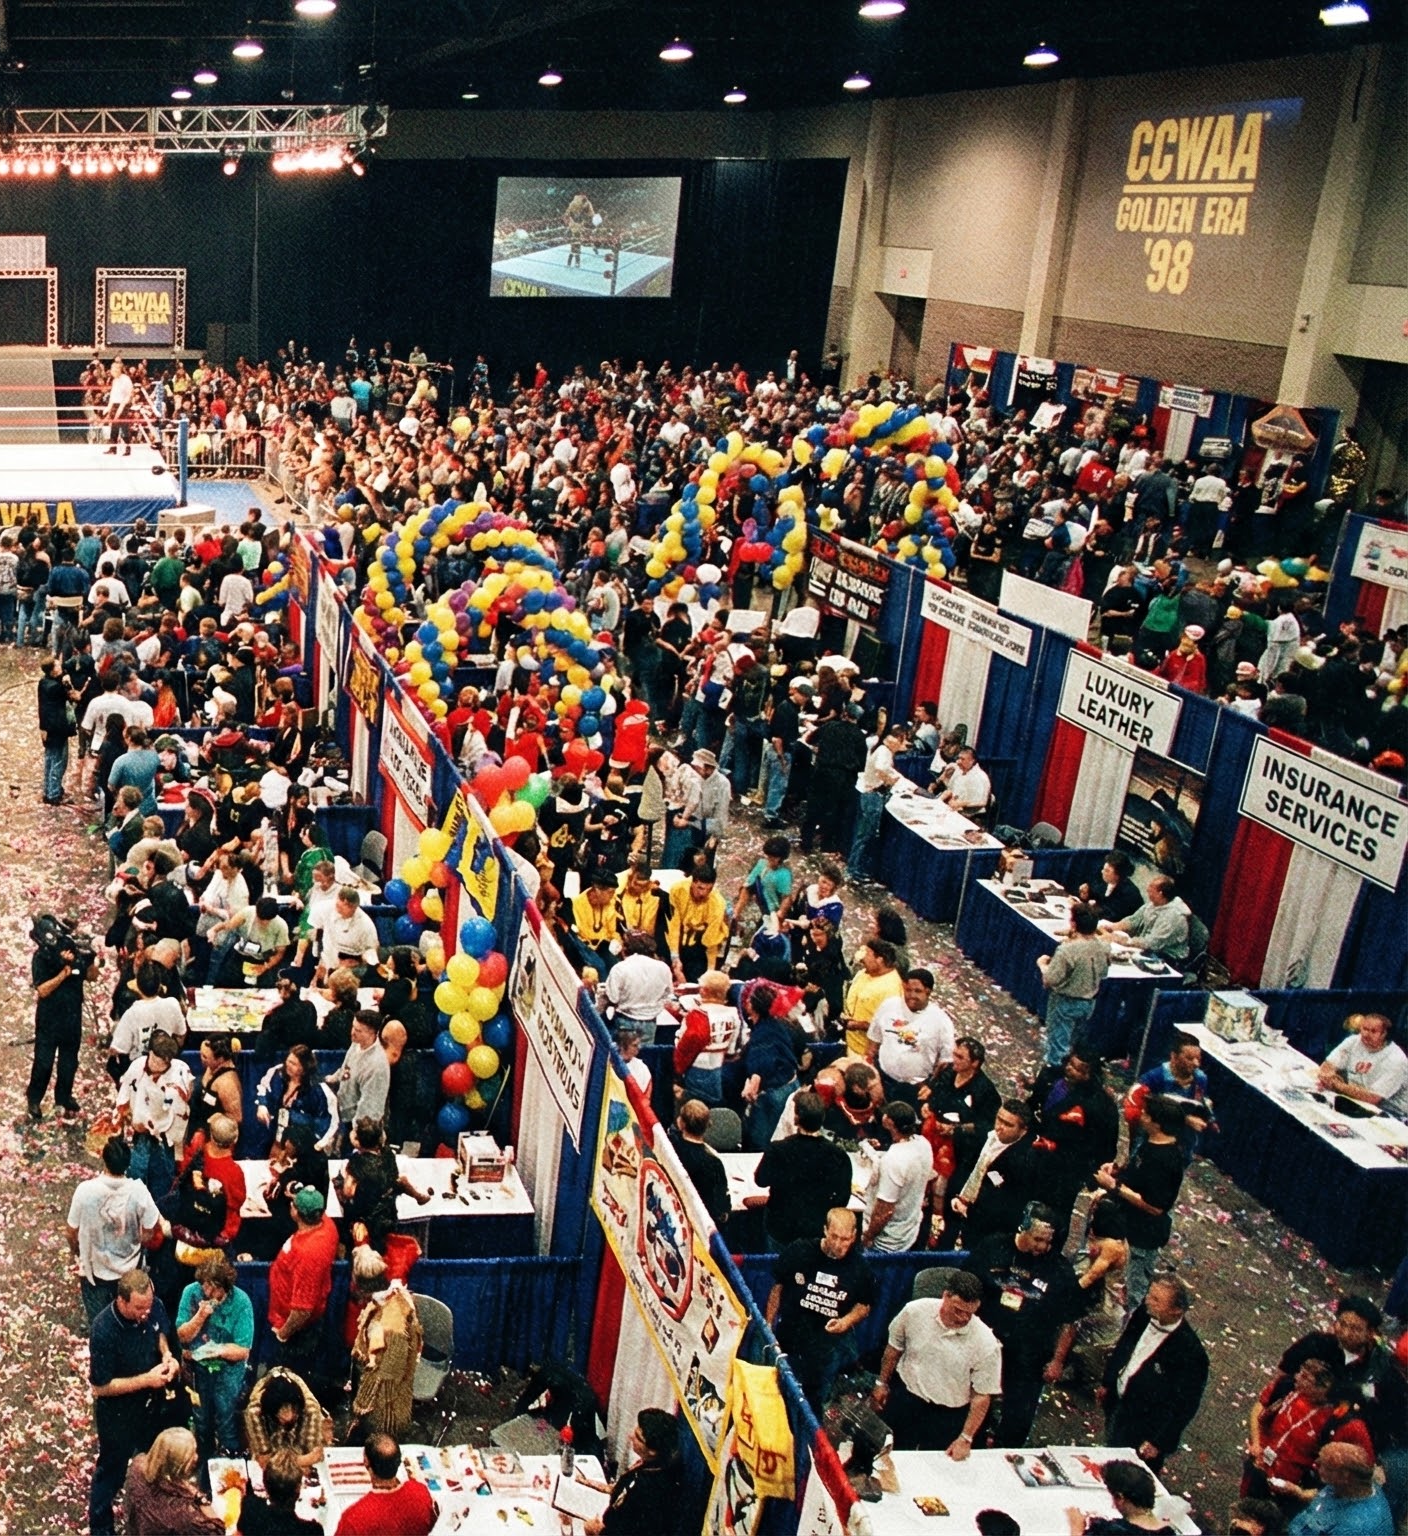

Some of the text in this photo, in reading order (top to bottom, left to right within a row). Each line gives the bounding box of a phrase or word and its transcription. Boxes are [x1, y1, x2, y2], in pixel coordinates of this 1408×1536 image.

[1126, 113, 1263, 182] CCWAA
[1116, 197, 1248, 235] GOLDEN ERA
[1145, 238, 1194, 295] '98
[110, 291, 170, 311] CCWAA
[1078, 694, 1154, 747] LEATHER
[1085, 671, 1154, 719] LUXURY
[1262, 755, 1400, 838] INSURANCE
[1265, 789, 1378, 862] SERVICES
